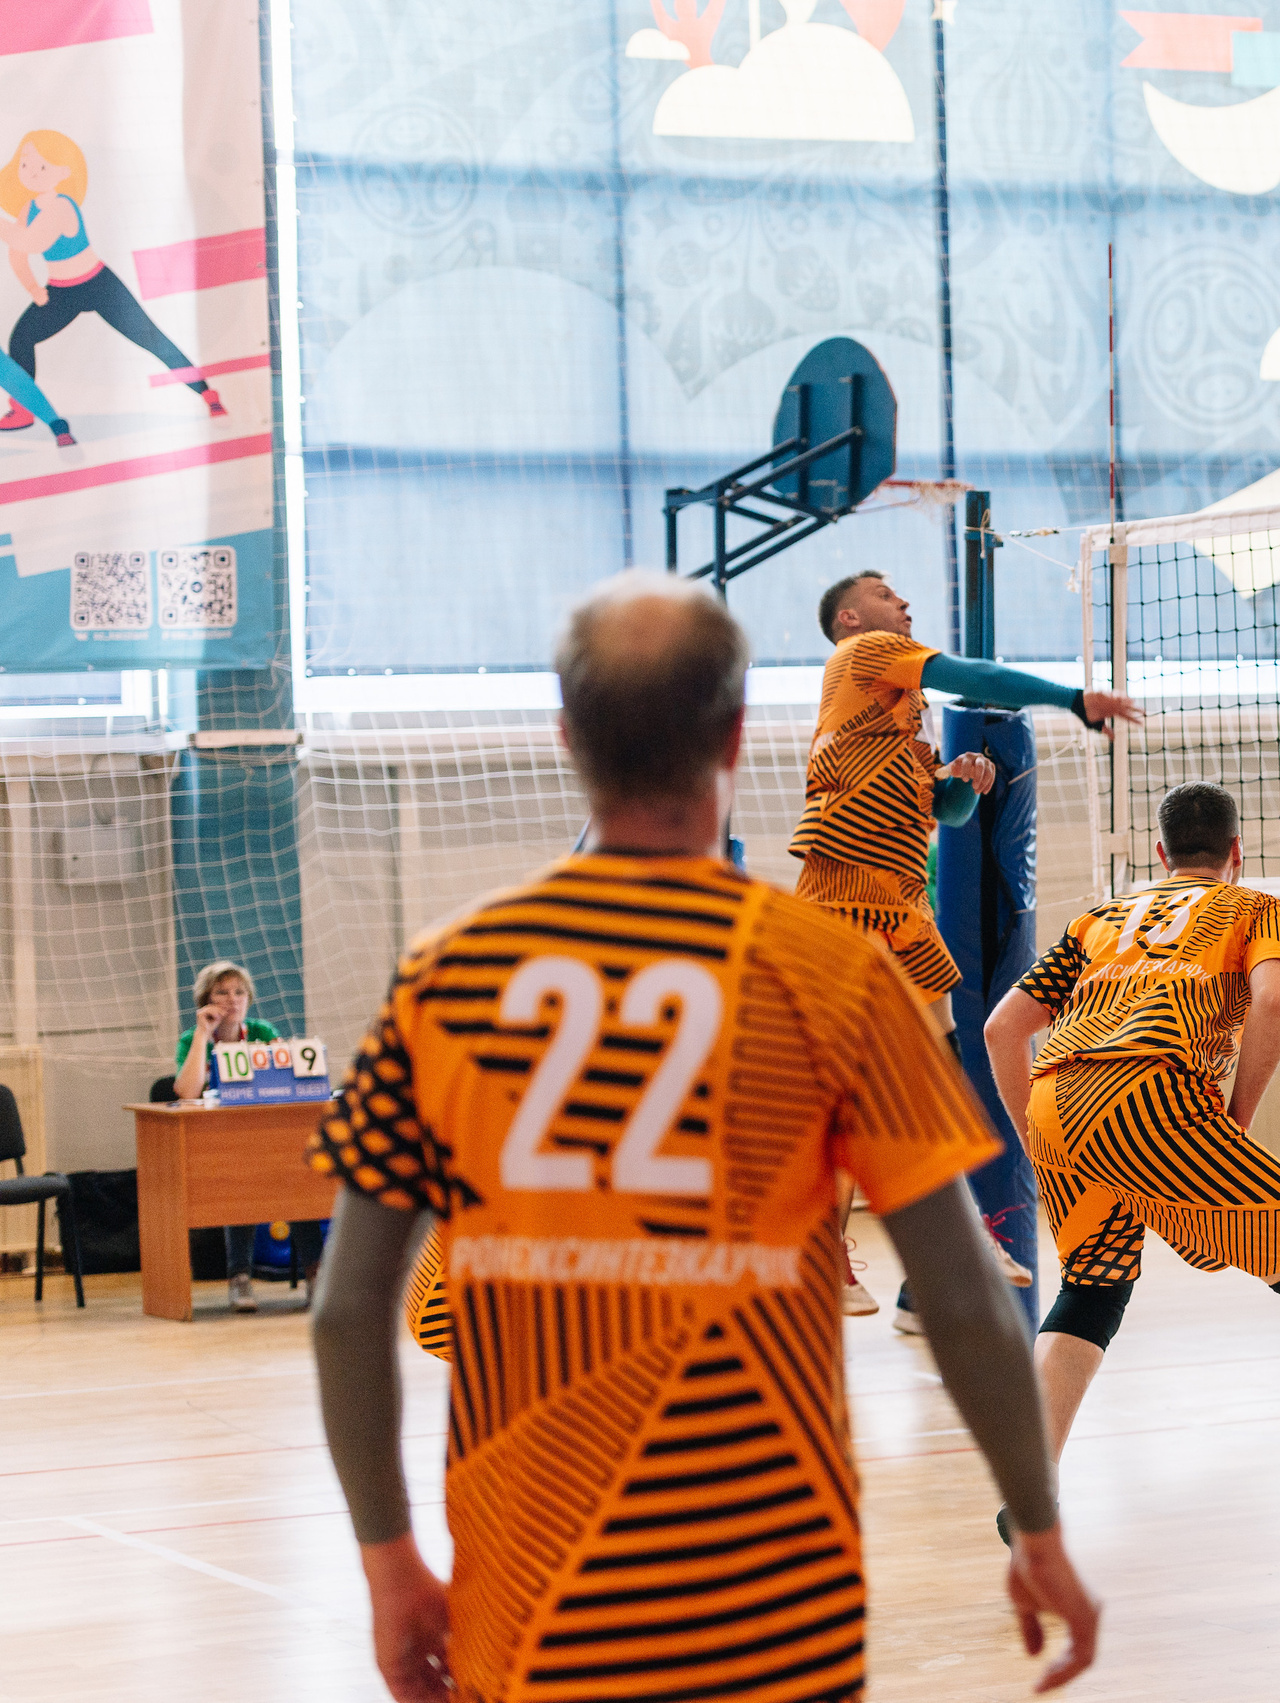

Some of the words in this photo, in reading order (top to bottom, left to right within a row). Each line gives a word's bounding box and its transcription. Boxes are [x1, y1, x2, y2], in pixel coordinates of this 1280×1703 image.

[223, 1051, 249, 1078] 10
[301, 1047, 317, 1070] 9
[501, 955, 723, 1195] 22
